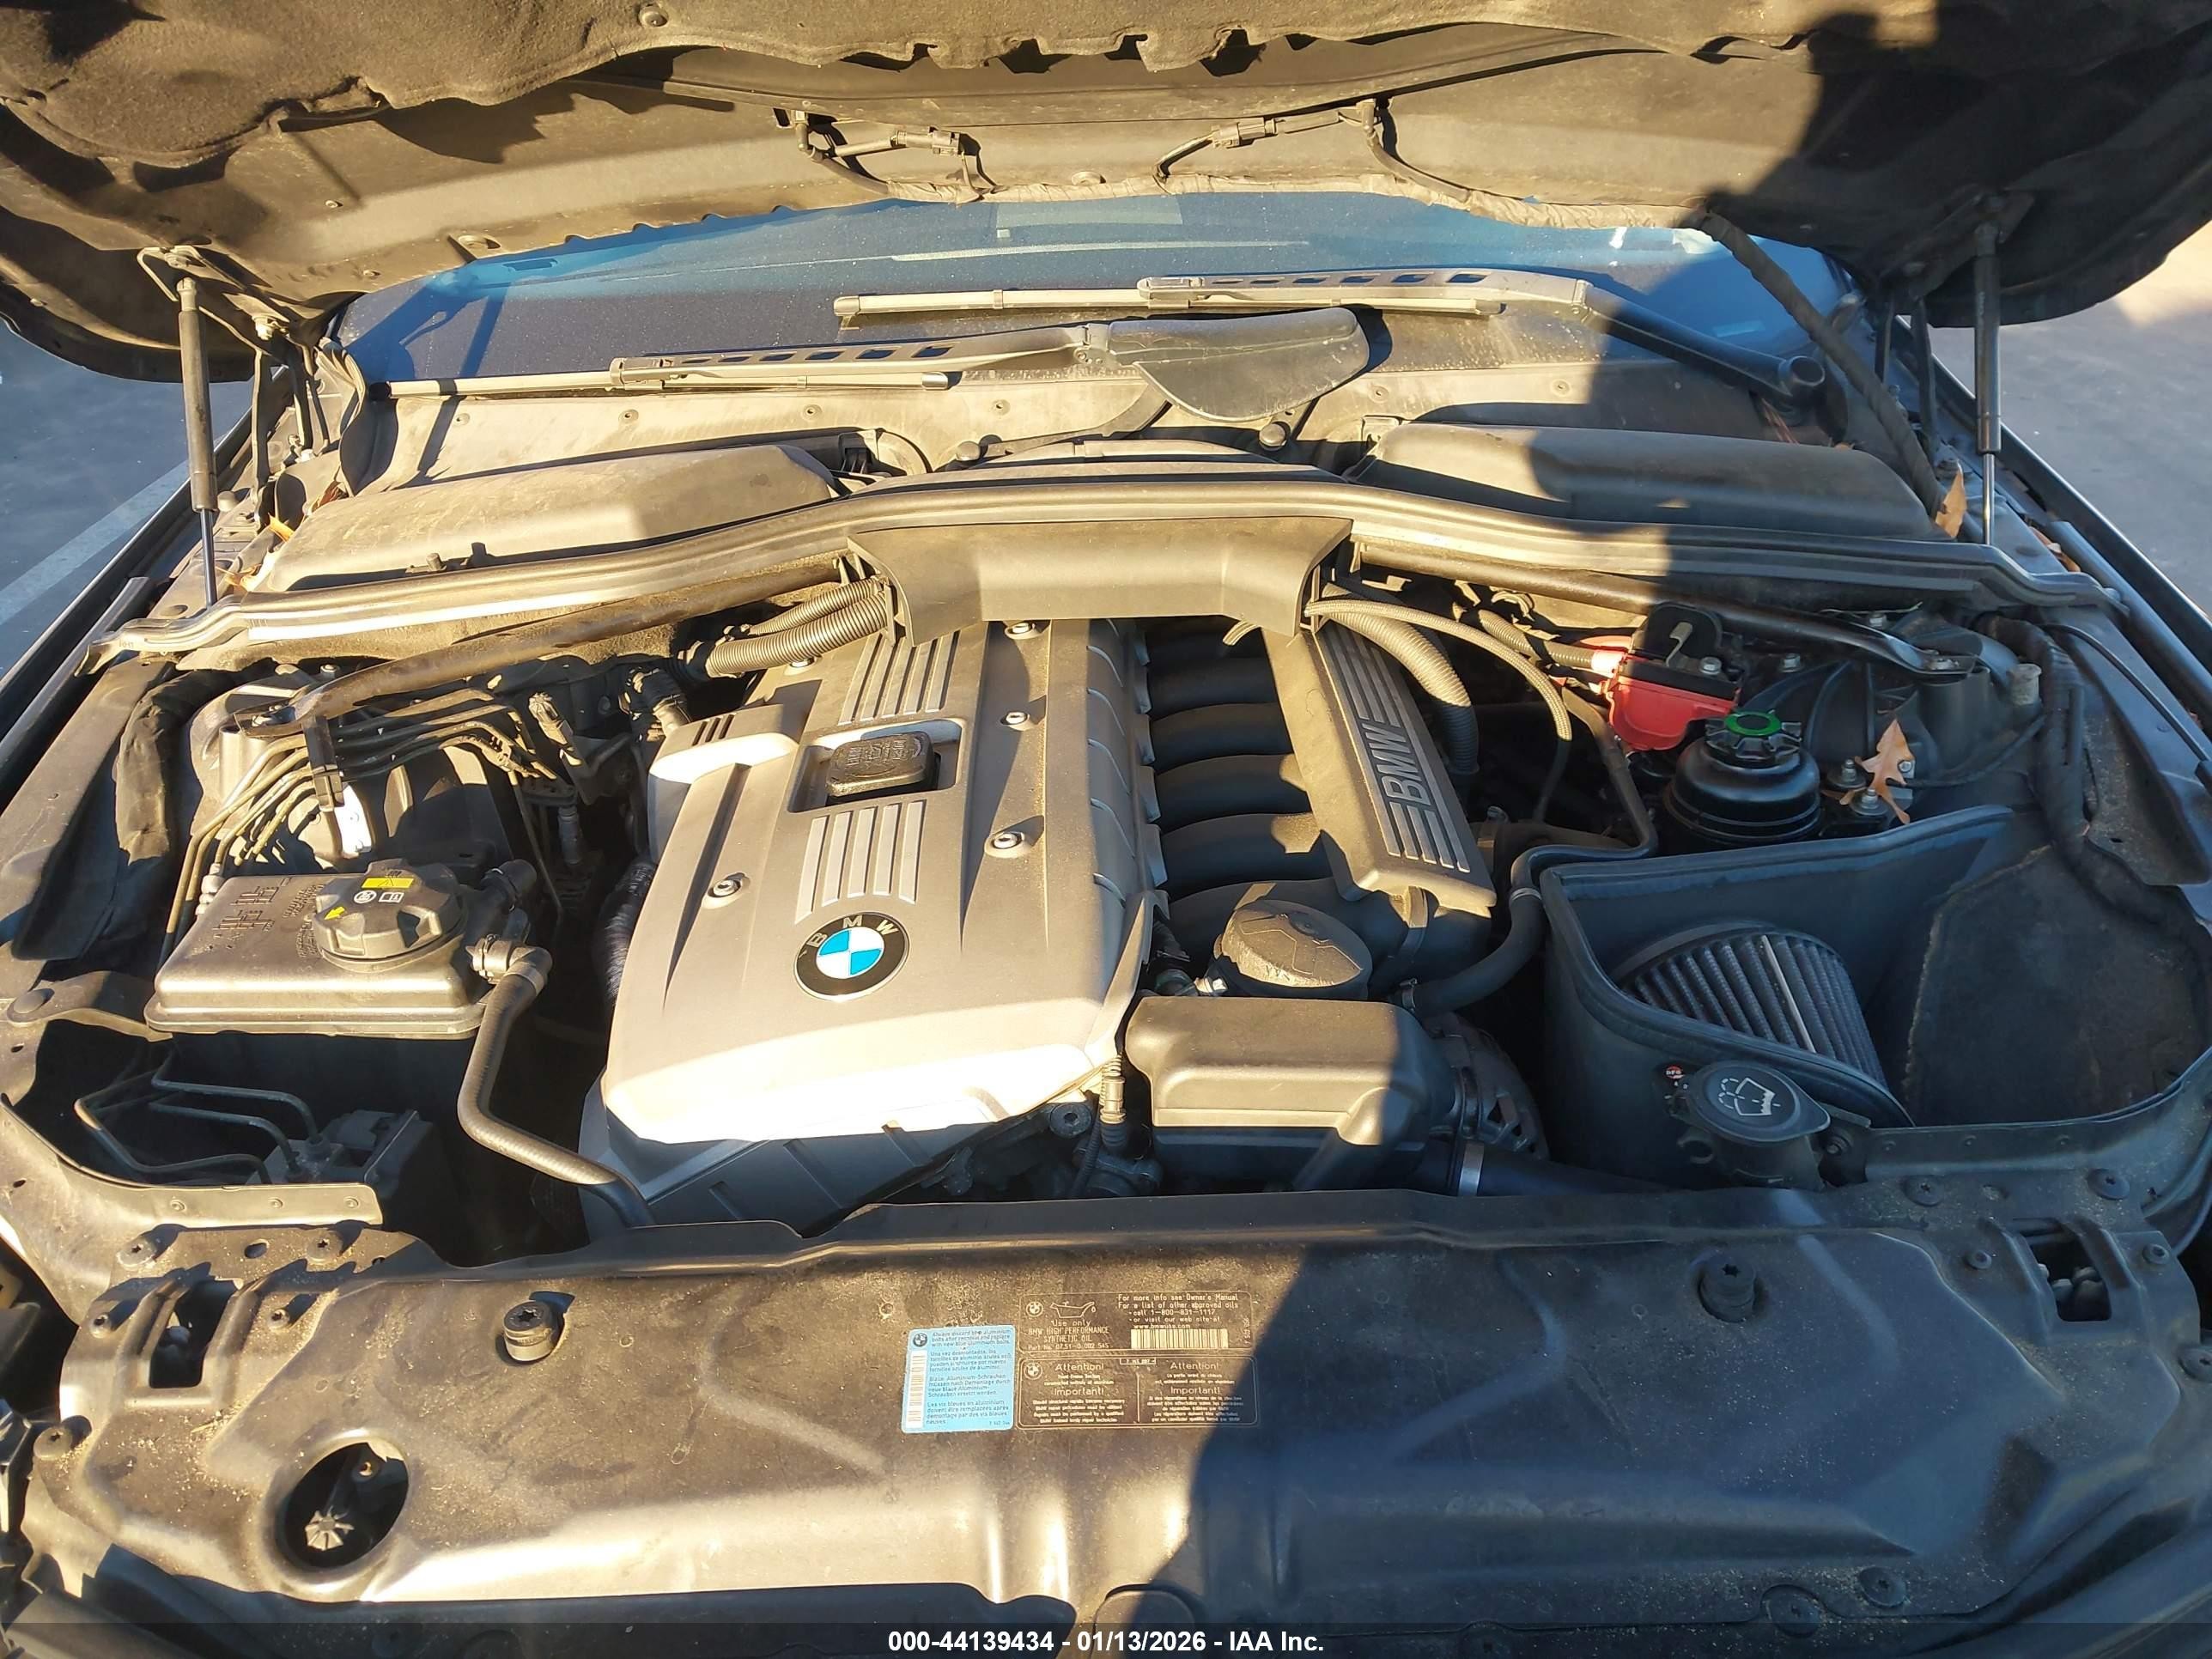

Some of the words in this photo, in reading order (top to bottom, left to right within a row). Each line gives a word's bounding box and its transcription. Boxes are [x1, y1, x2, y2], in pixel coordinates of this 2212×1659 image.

[1362, 723, 1431, 805] BMW
[806, 915, 899, 948] BMW
[1191, 1302, 1222, 1310] approved
[1054, 1363, 1104, 1371] Attention!
[1170, 1362, 1220, 1370] Attention!
[1054, 1387, 1104, 1396] Important!
[1170, 1386, 1220, 1395] Important!
